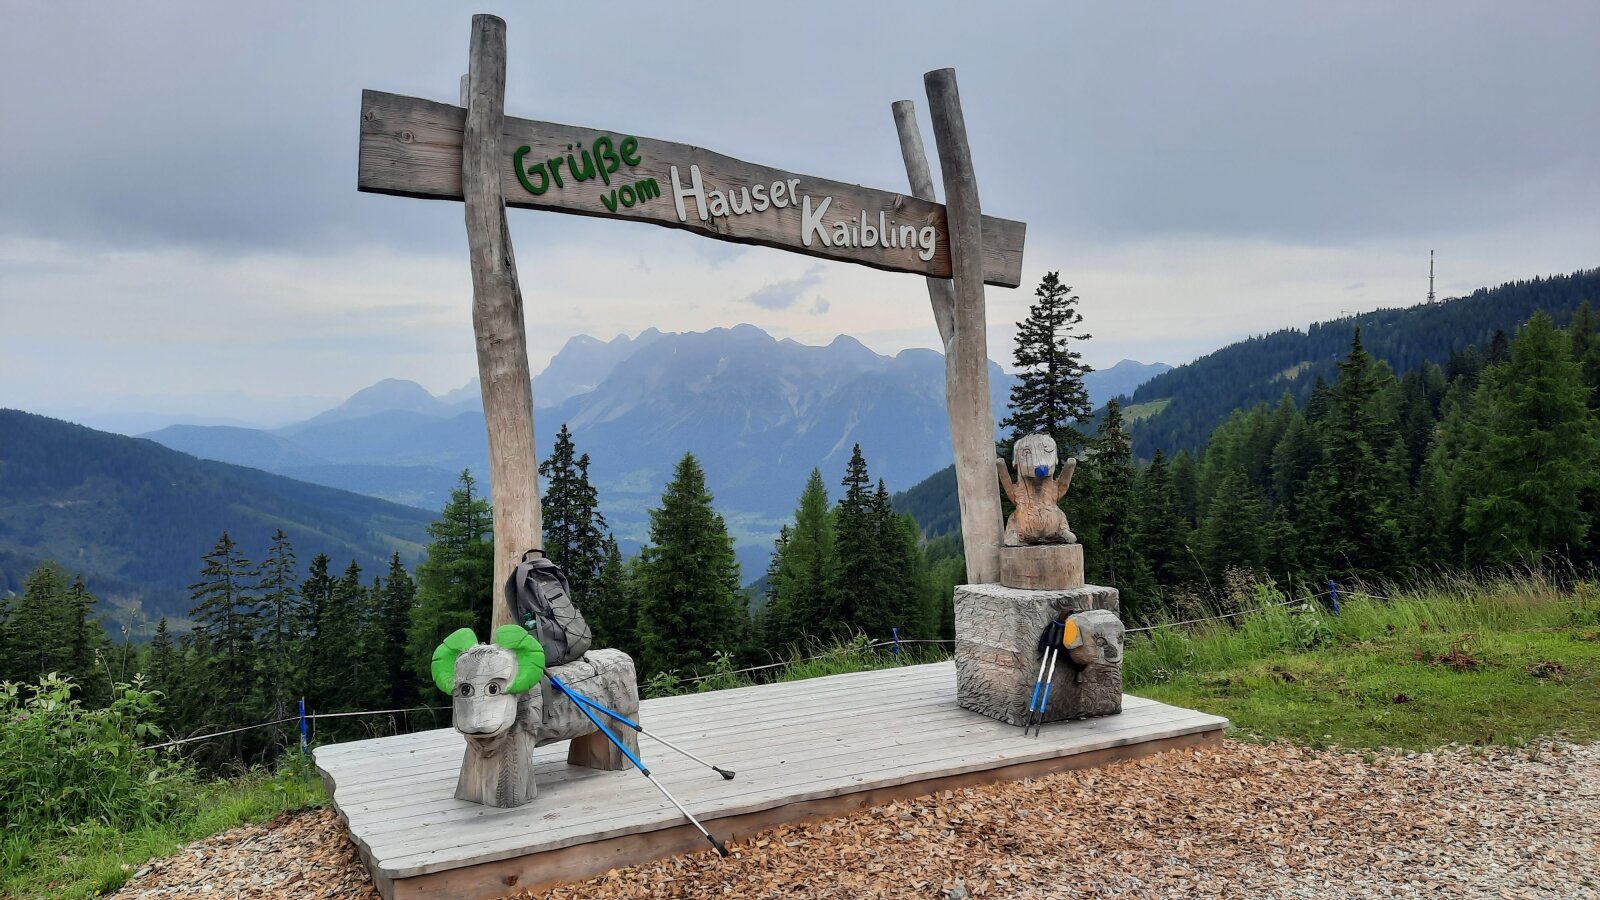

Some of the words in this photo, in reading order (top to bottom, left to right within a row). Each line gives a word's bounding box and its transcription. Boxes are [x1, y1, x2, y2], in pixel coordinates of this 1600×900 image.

[513, 135, 642, 195] Grüße
[600, 176, 661, 212] vom
[670, 164, 801, 222] Hauser
[801, 195, 936, 261] Kaibling
